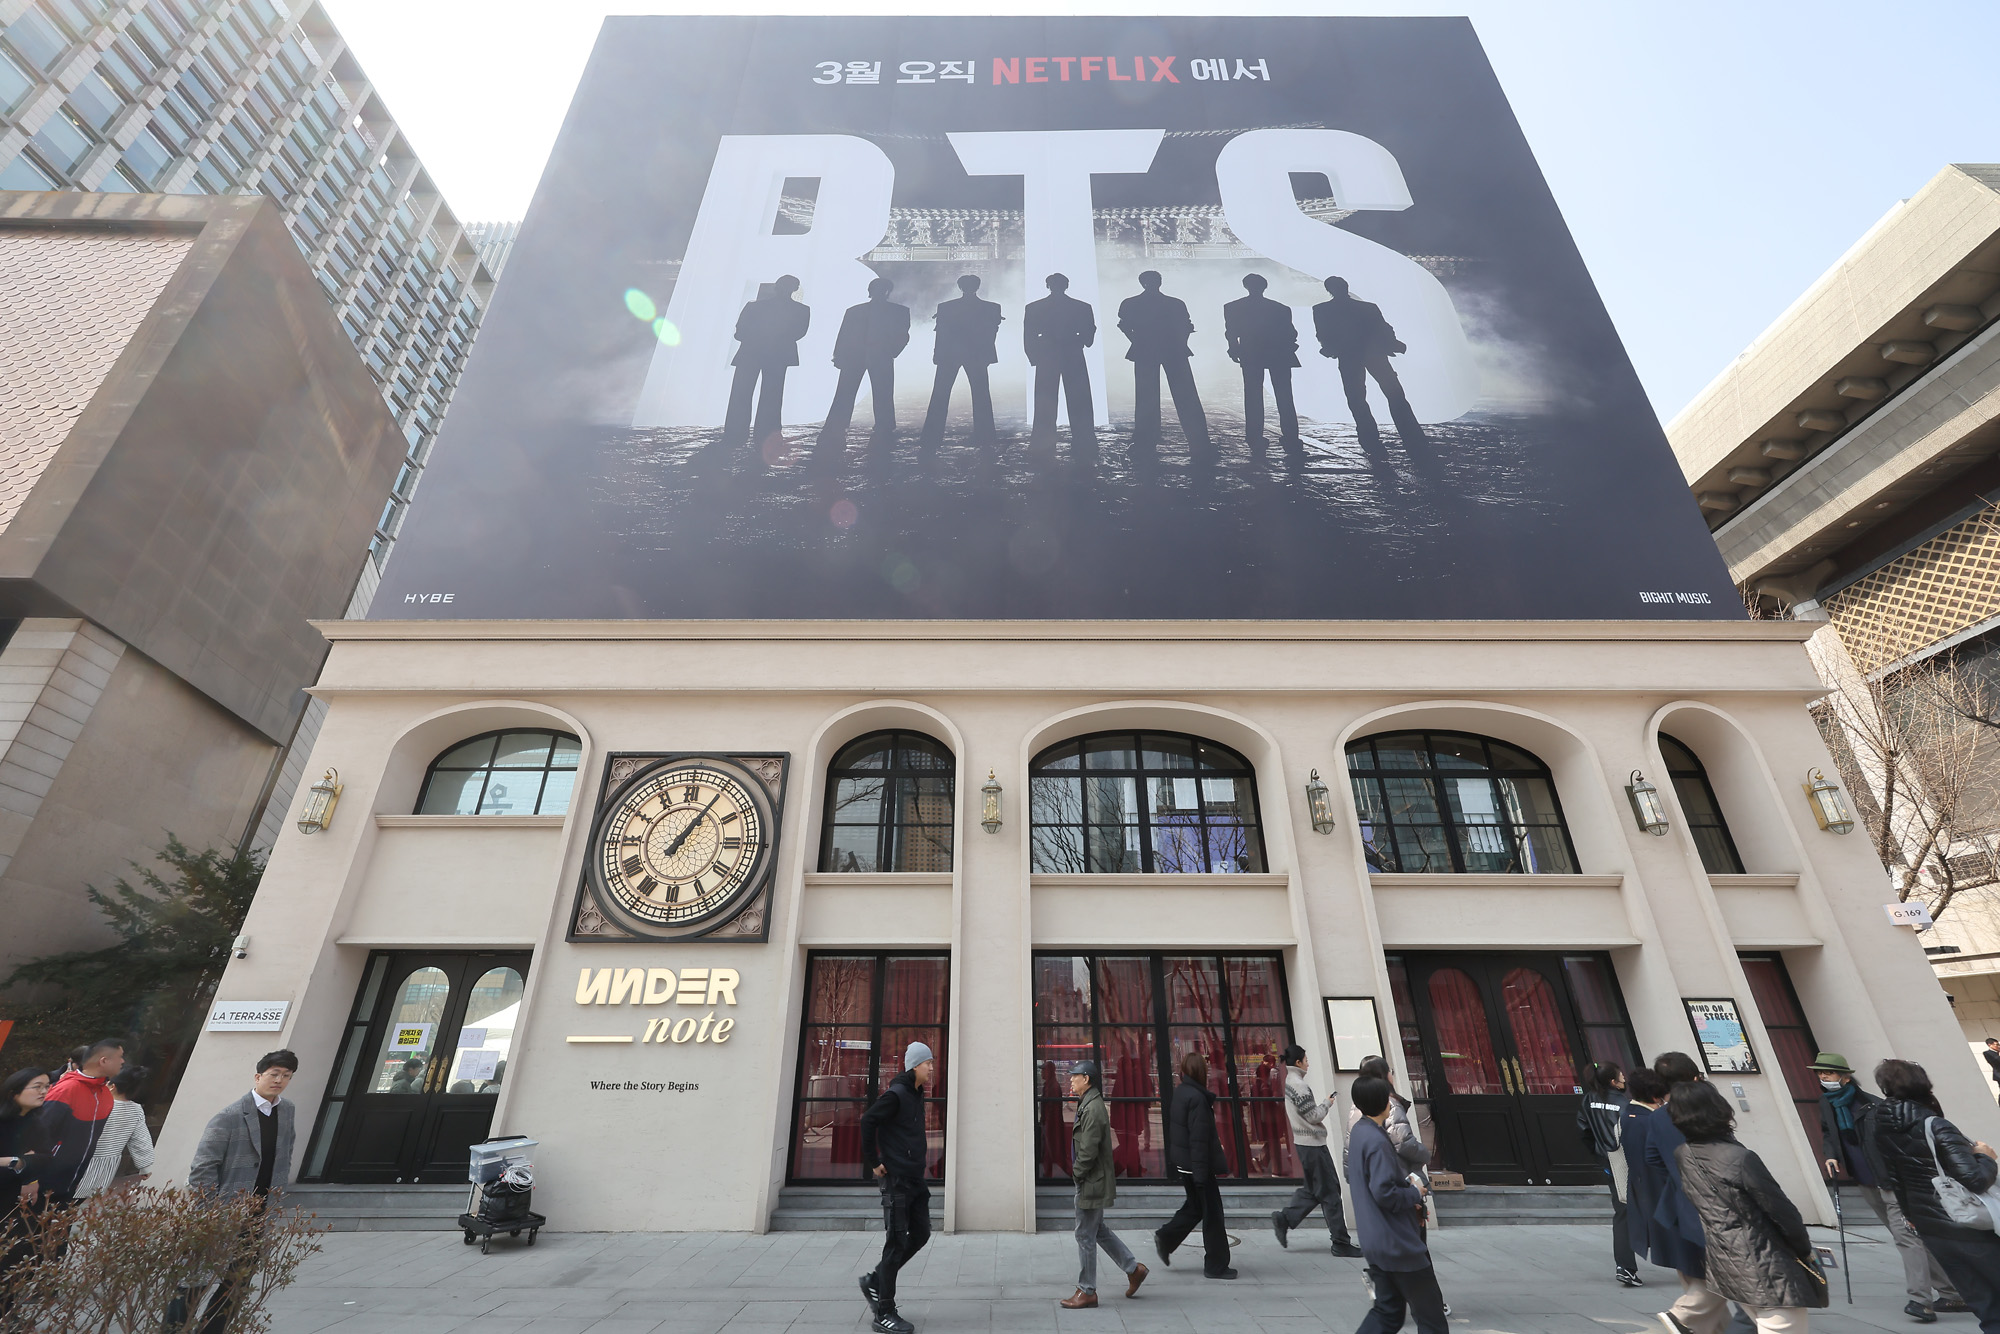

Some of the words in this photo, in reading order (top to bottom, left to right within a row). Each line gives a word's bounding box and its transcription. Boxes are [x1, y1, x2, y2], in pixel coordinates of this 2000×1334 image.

[812, 60, 882, 85] 3월
[896, 60, 976, 85] 오직
[992, 56, 1181, 86] NETFLIX
[1190, 57, 1271, 82] 에서
[631, 128, 1474, 428] BTS
[403, 593, 456, 604] HYBE
[1638, 591, 1675, 604] BIGHIT
[1675, 592, 1712, 605] MUSIC
[1894, 909, 1922, 918] G.169
[1712, 1004, 1725, 1013] ON
[212, 1011, 226, 1021] LA
[229, 1011, 283, 1021] TERRASSE
[641, 1011, 736, 1044] note
[590, 1080, 621, 1090] Where
[623, 1080, 639, 1090] the
[640, 1081, 666, 1092] Story
[667, 1081, 700, 1093] Begins
